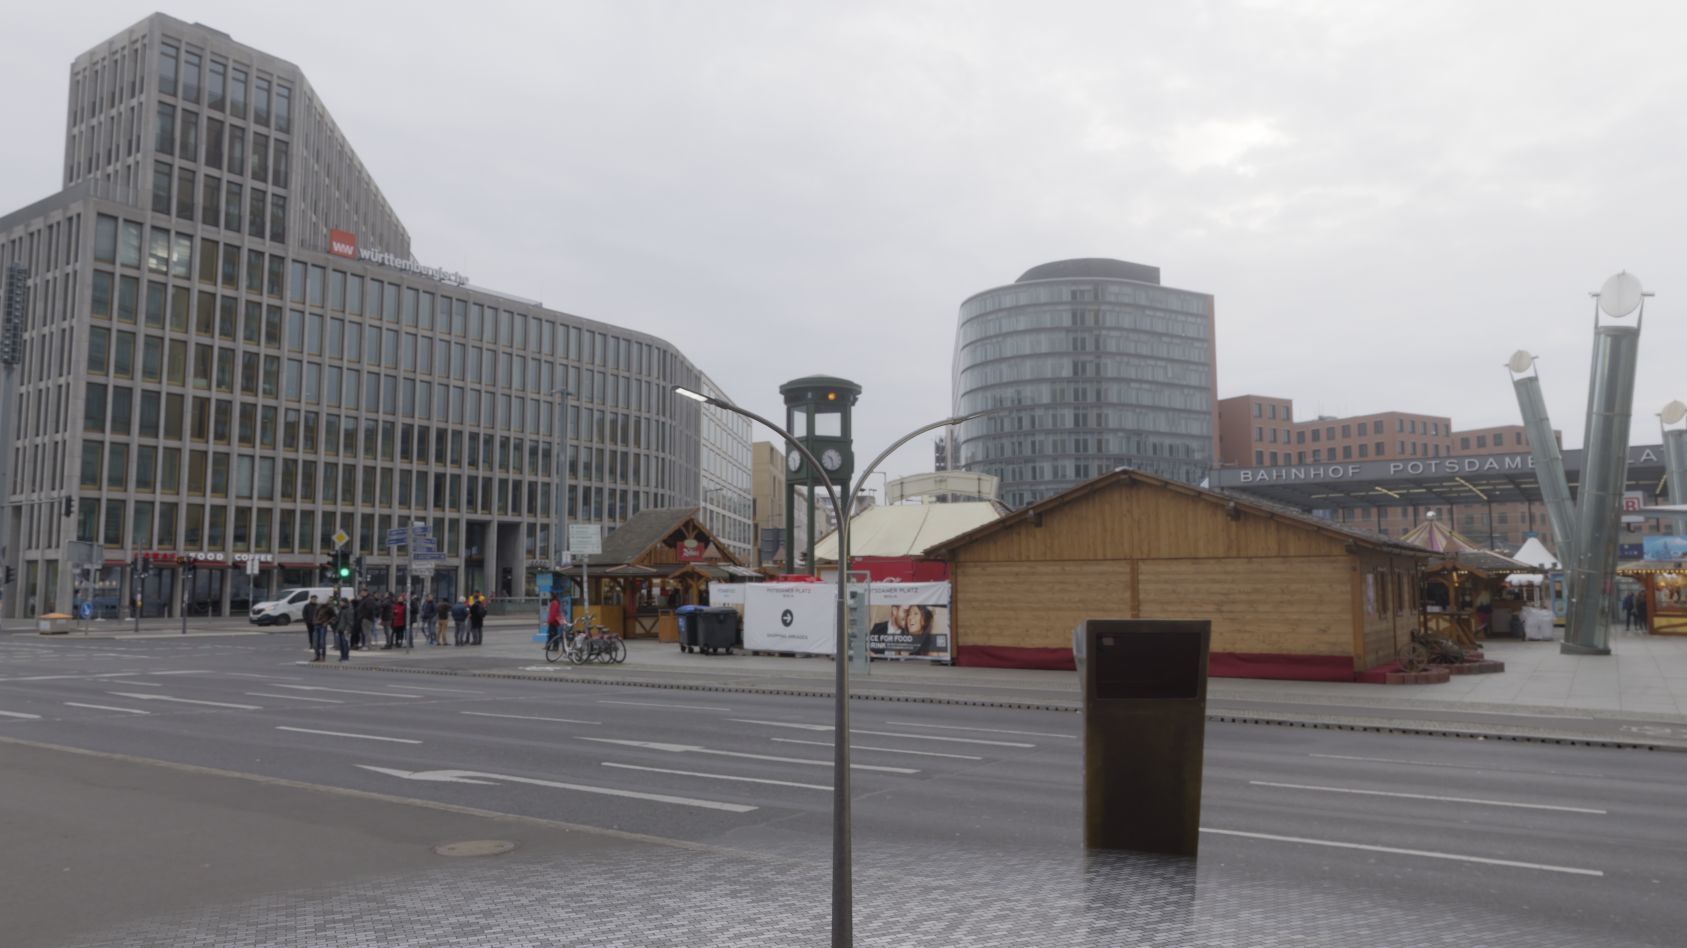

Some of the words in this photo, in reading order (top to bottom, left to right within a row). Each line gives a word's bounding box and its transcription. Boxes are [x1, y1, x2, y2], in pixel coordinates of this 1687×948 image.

[1240, 465, 1361, 482] BAHNHOF
[1390, 456, 1536, 475] POTSDAME
[895, 635, 913, 643] FOOD
